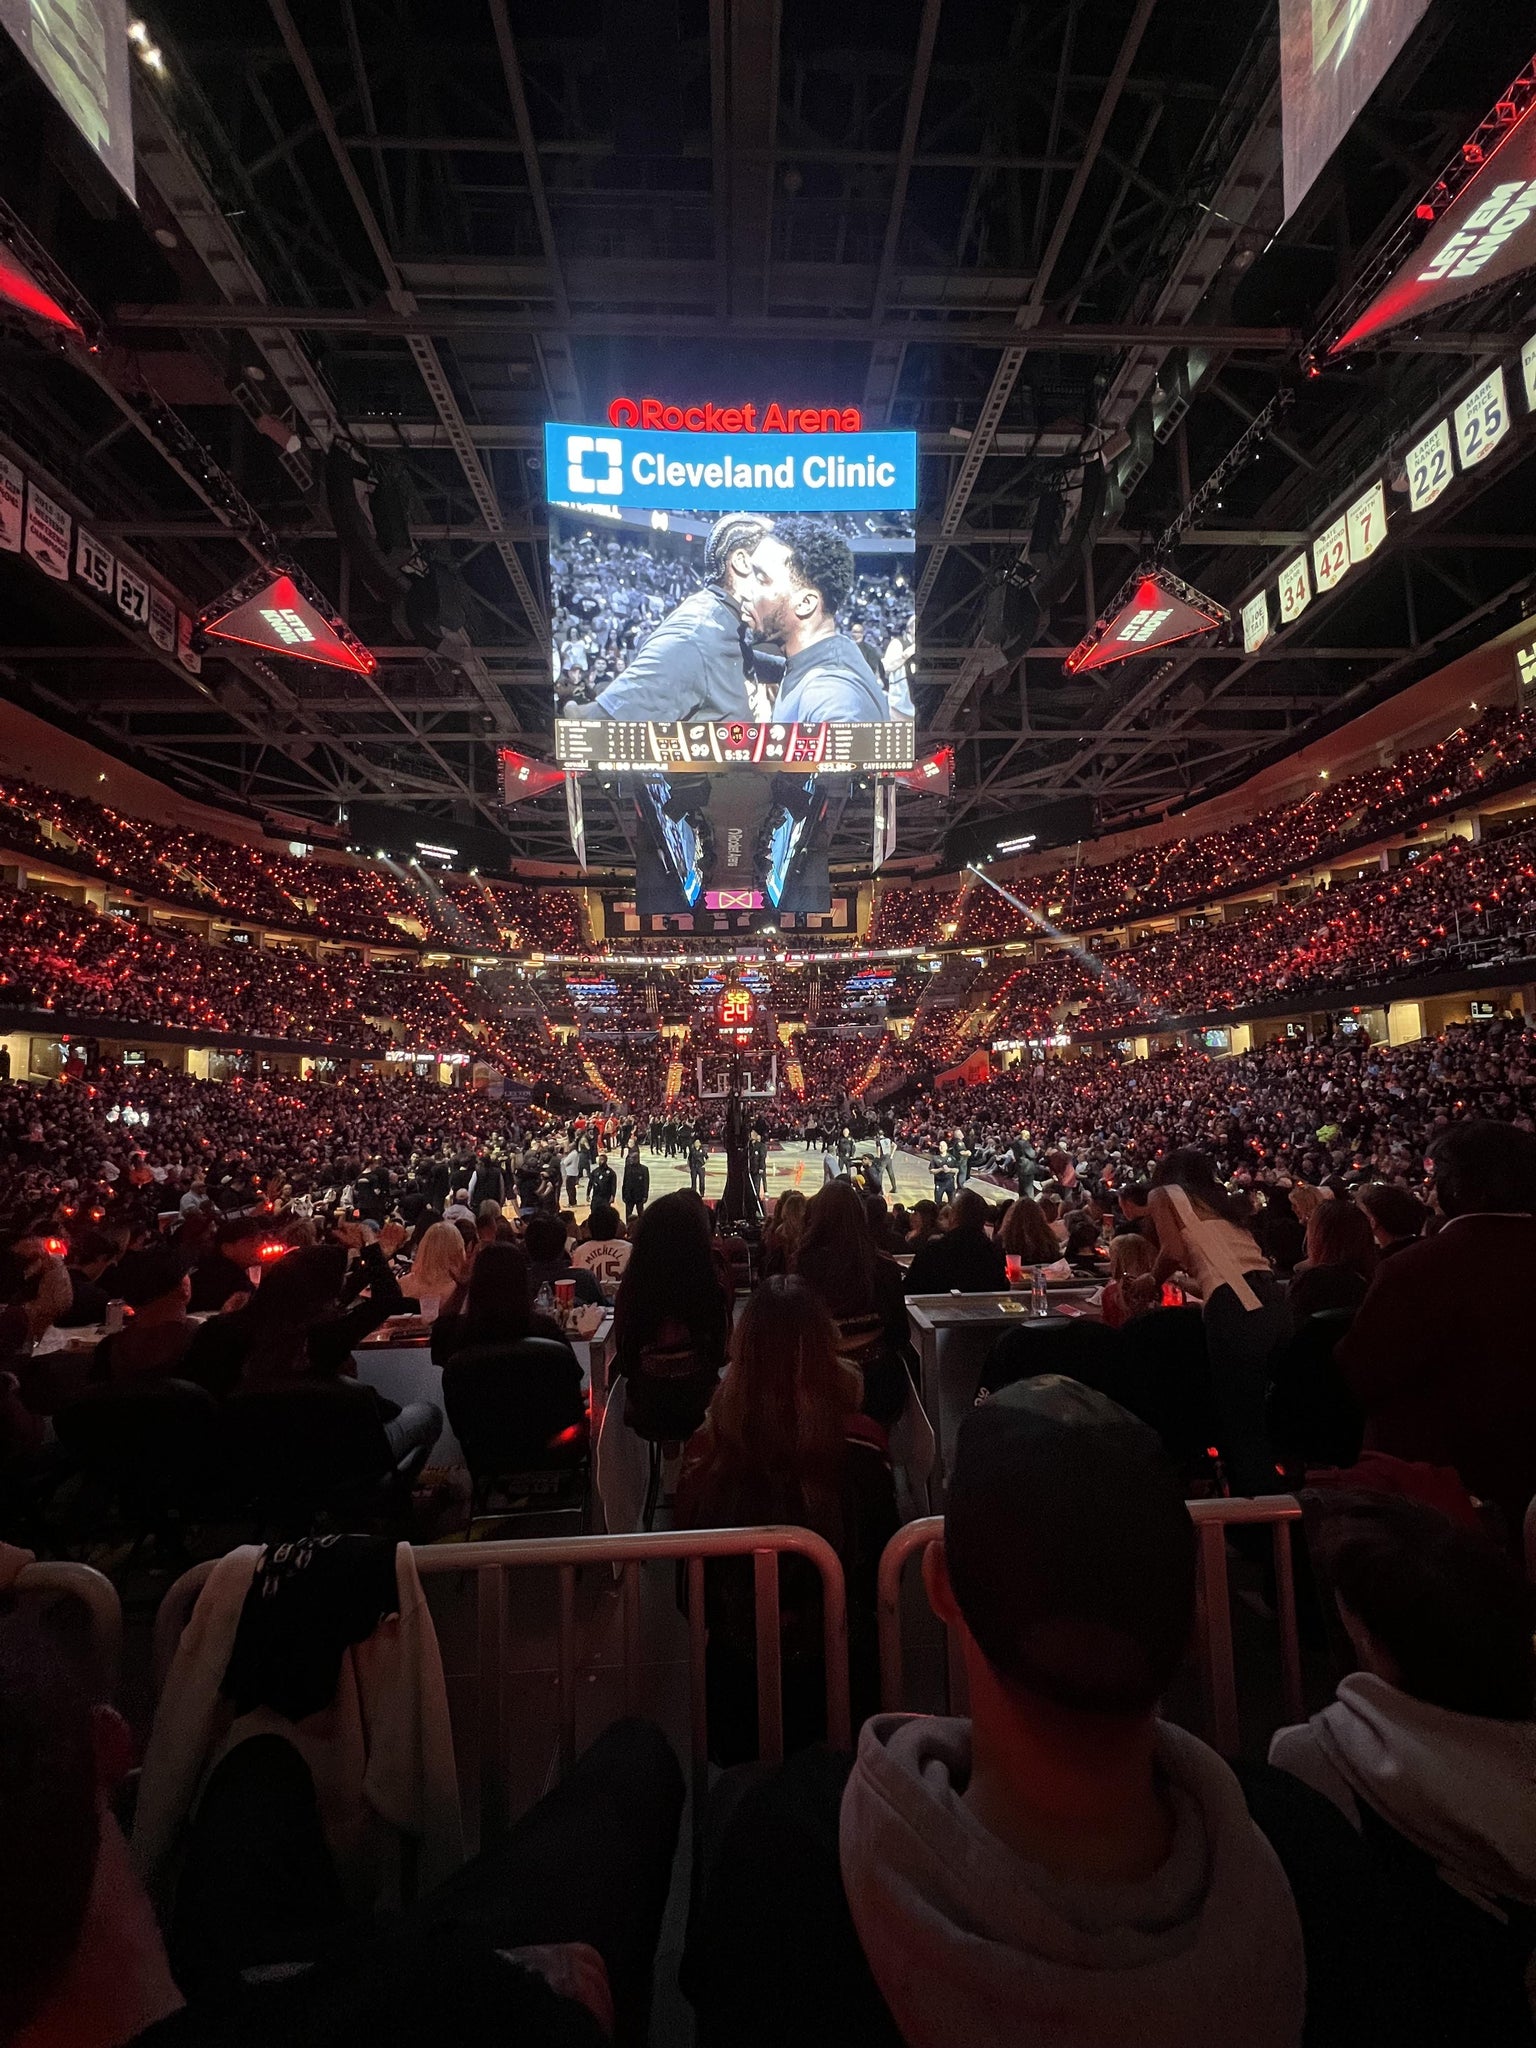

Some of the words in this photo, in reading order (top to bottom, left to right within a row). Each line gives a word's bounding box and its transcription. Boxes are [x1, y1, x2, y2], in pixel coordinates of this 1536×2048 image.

[1417, 232, 1477, 281] LET
[1466, 383, 1492, 410] MARK
[1467, 391, 1493, 419] PRICE
[641, 398, 756, 432] Rocket
[762, 403, 861, 433] Arena
[1464, 398, 1502, 457] 25
[1414, 431, 1439, 459] LARRY
[1414, 439, 1440, 467] NANCE
[631, 452, 794, 488] Cleveland
[802, 455, 896, 488] Clinic
[1414, 449, 1446, 501] 22
[1355, 500, 1376, 520] SMITH
[1361, 513, 1372, 544] 7
[83, 547, 108, 588] 15
[1320, 541, 1344, 578] 42
[121, 579, 144, 618] 27
[1284, 575, 1306, 612] 34
[1251, 616, 1265, 632] TAIT
[690, 744, 710, 757] 99
[725, 750, 750, 760] 5:52
[766, 744, 784, 758] 84
[724, 1004, 748, 1022] 24
[585, 1244, 623, 1264] MITCHELL
